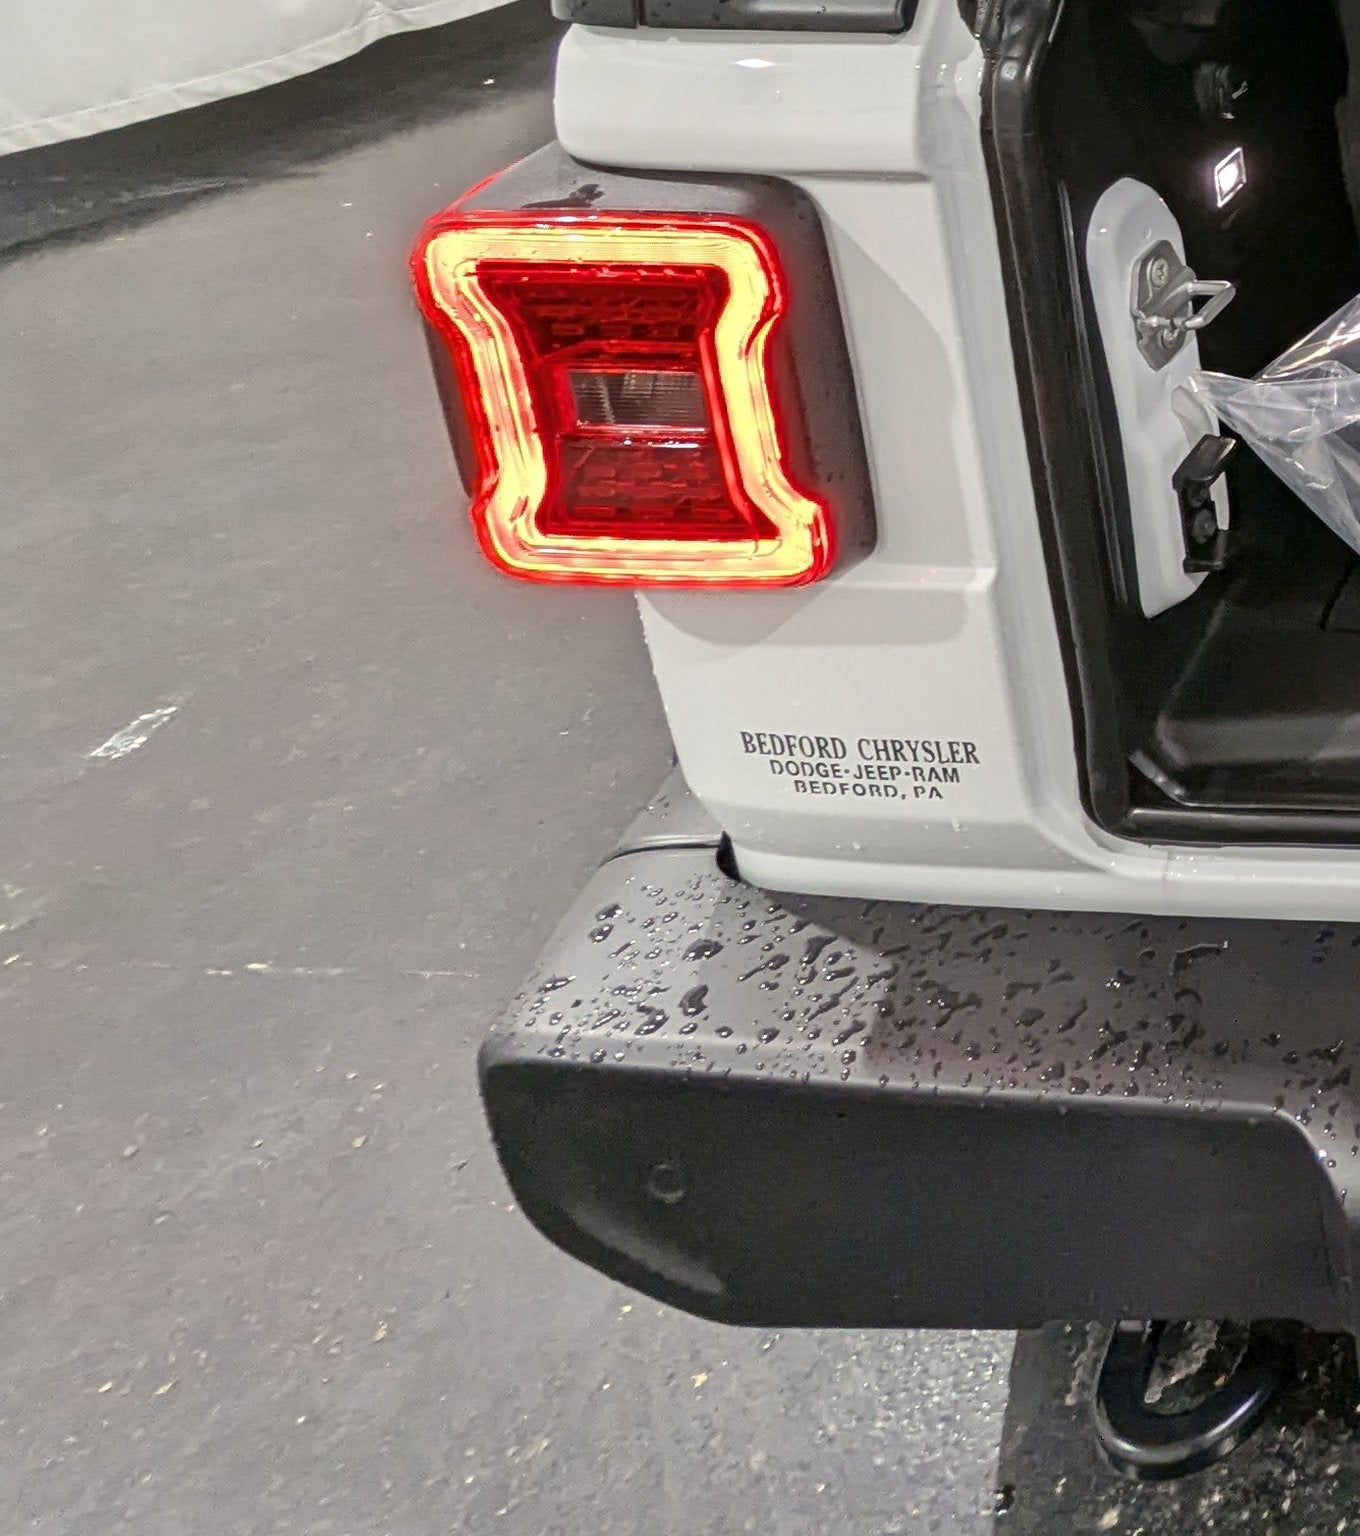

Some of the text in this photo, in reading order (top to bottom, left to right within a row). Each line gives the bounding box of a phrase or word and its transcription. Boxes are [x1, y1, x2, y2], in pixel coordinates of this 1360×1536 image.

[740, 731, 981, 765] BEDFORD CHRYSLER
[794, 779, 944, 800] BEDFORD, PA
